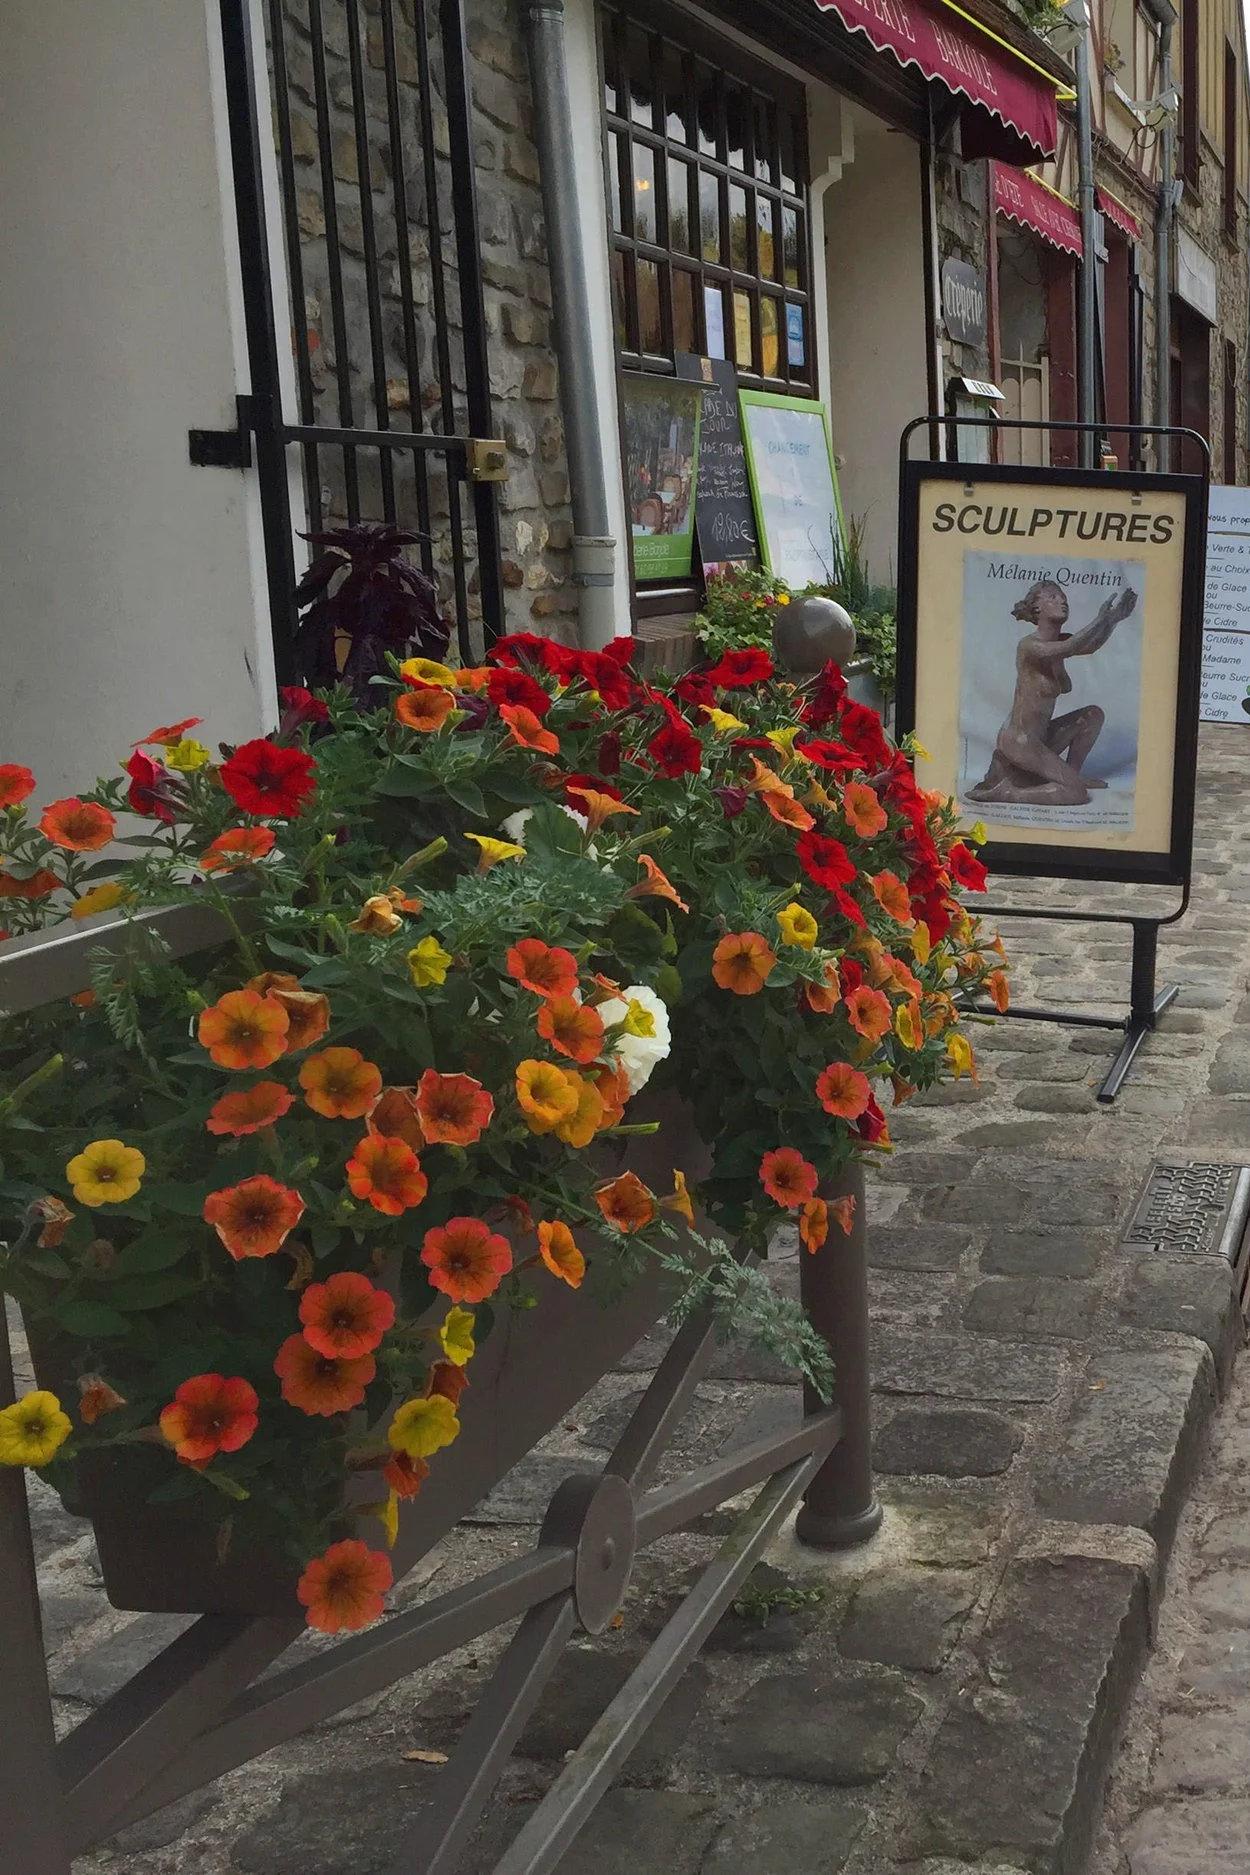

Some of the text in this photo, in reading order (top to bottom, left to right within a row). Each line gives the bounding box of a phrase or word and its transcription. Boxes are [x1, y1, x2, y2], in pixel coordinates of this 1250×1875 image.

[932, 503, 1175, 545] SCULPTURES
[1212, 544, 1235, 554] Verte
[1210, 564, 1250, 574] au Choix
[987, 563, 1123, 587] Mélanie Quentin
[1207, 582, 1248, 593] de Glace
[1206, 592, 1218, 600] ou
[1213, 616, 1238, 627] Cidre
[1206, 633, 1245, 646] Crudités
[1202, 654, 1242, 665] Madame
[1200, 671, 1227, 681] eurre
[1211, 691, 1238, 702] Glace
